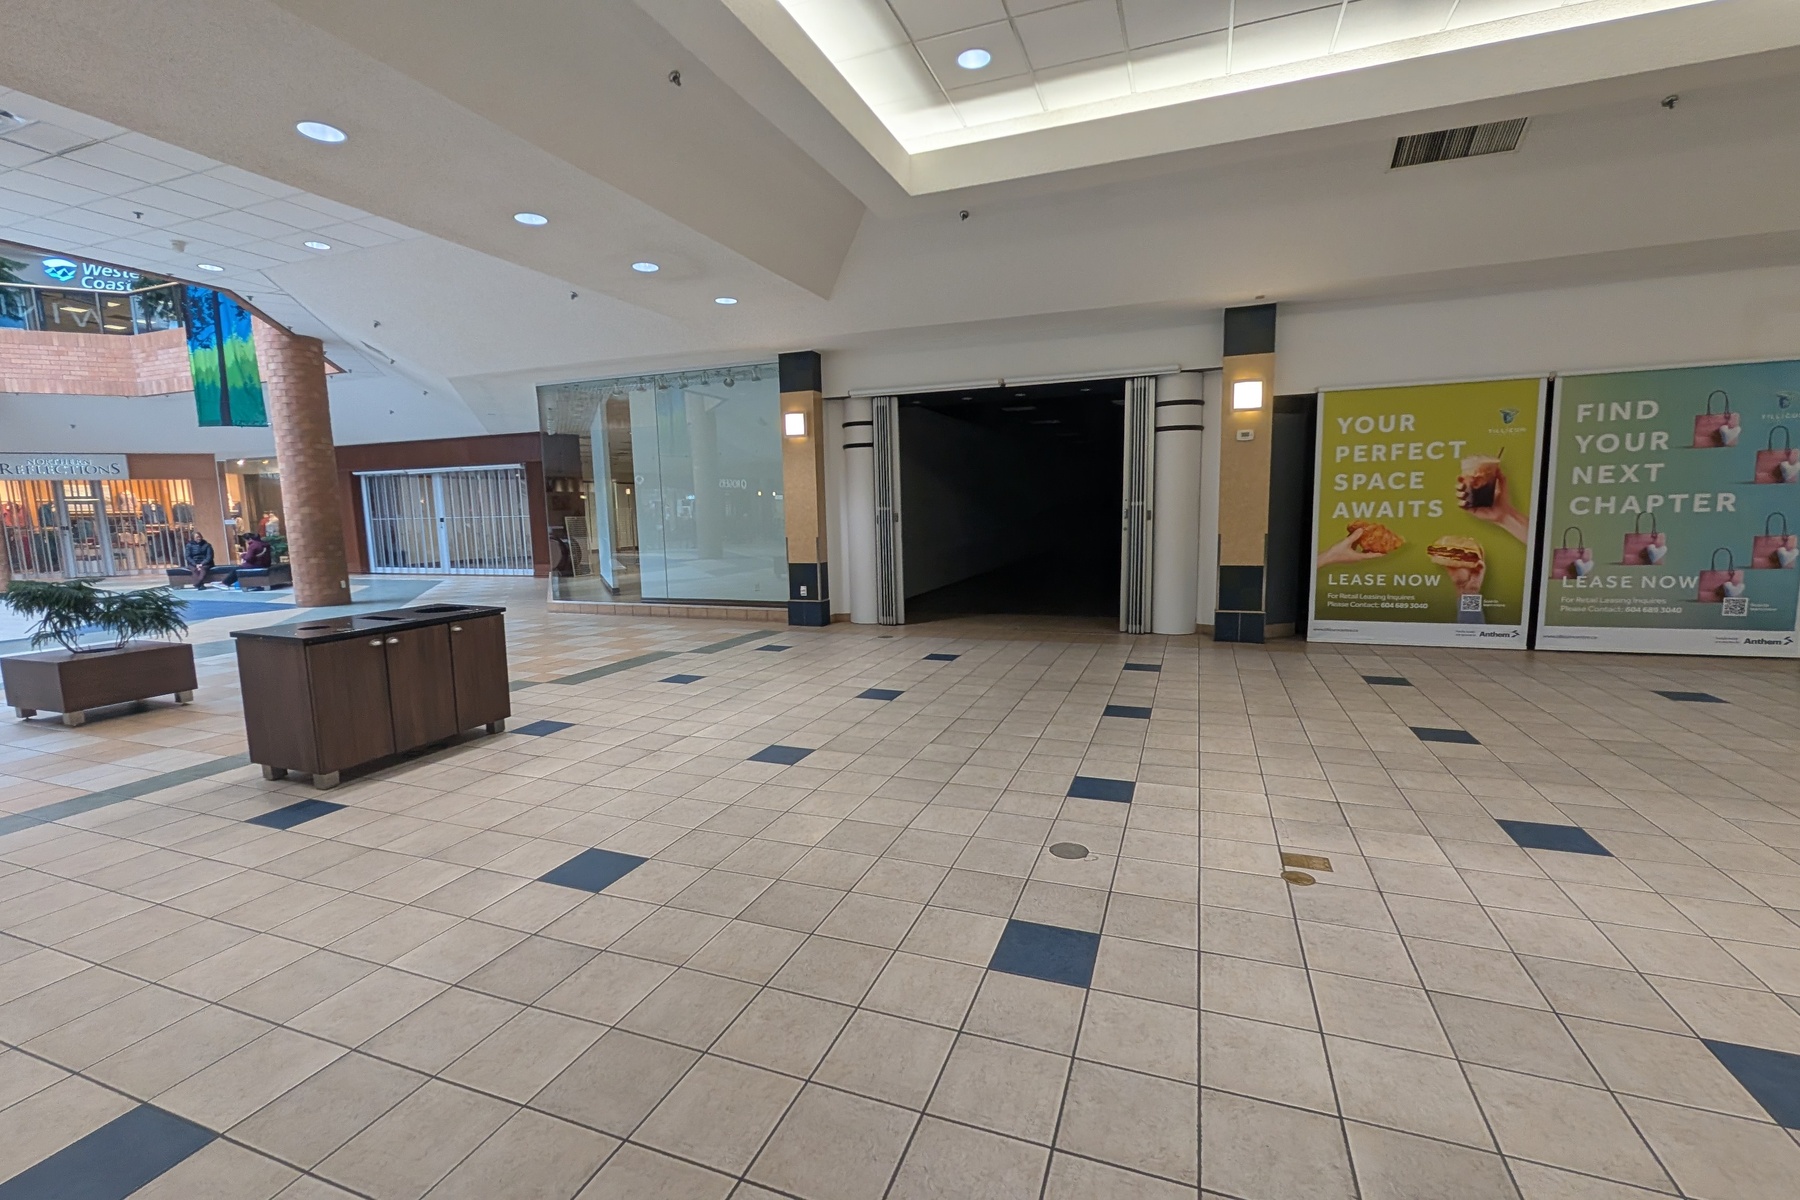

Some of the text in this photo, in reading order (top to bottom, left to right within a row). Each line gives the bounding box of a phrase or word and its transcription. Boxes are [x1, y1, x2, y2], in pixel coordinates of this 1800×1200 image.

[82, 262, 140, 279] Weste
[1576, 400, 1660, 423] FIND
[1761, 412, 1800, 420] TILLICU
[1336, 414, 1416, 435] YOUR
[1335, 441, 1467, 463] PERFECT
[1574, 431, 1670, 454] YOUR
[0, 462, 121, 475] REFLECTIONS
[1571, 463, 1665, 485] NEXT
[1333, 471, 1425, 491] SPACE
[1332, 500, 1444, 519] AWAITS
[1569, 492, 1737, 515] CHAPTER
[1328, 574, 1441, 587] LEASE NOW
[1562, 575, 1699, 589] LEASE NOW
[1359, 593, 1387, 601] Leasing
